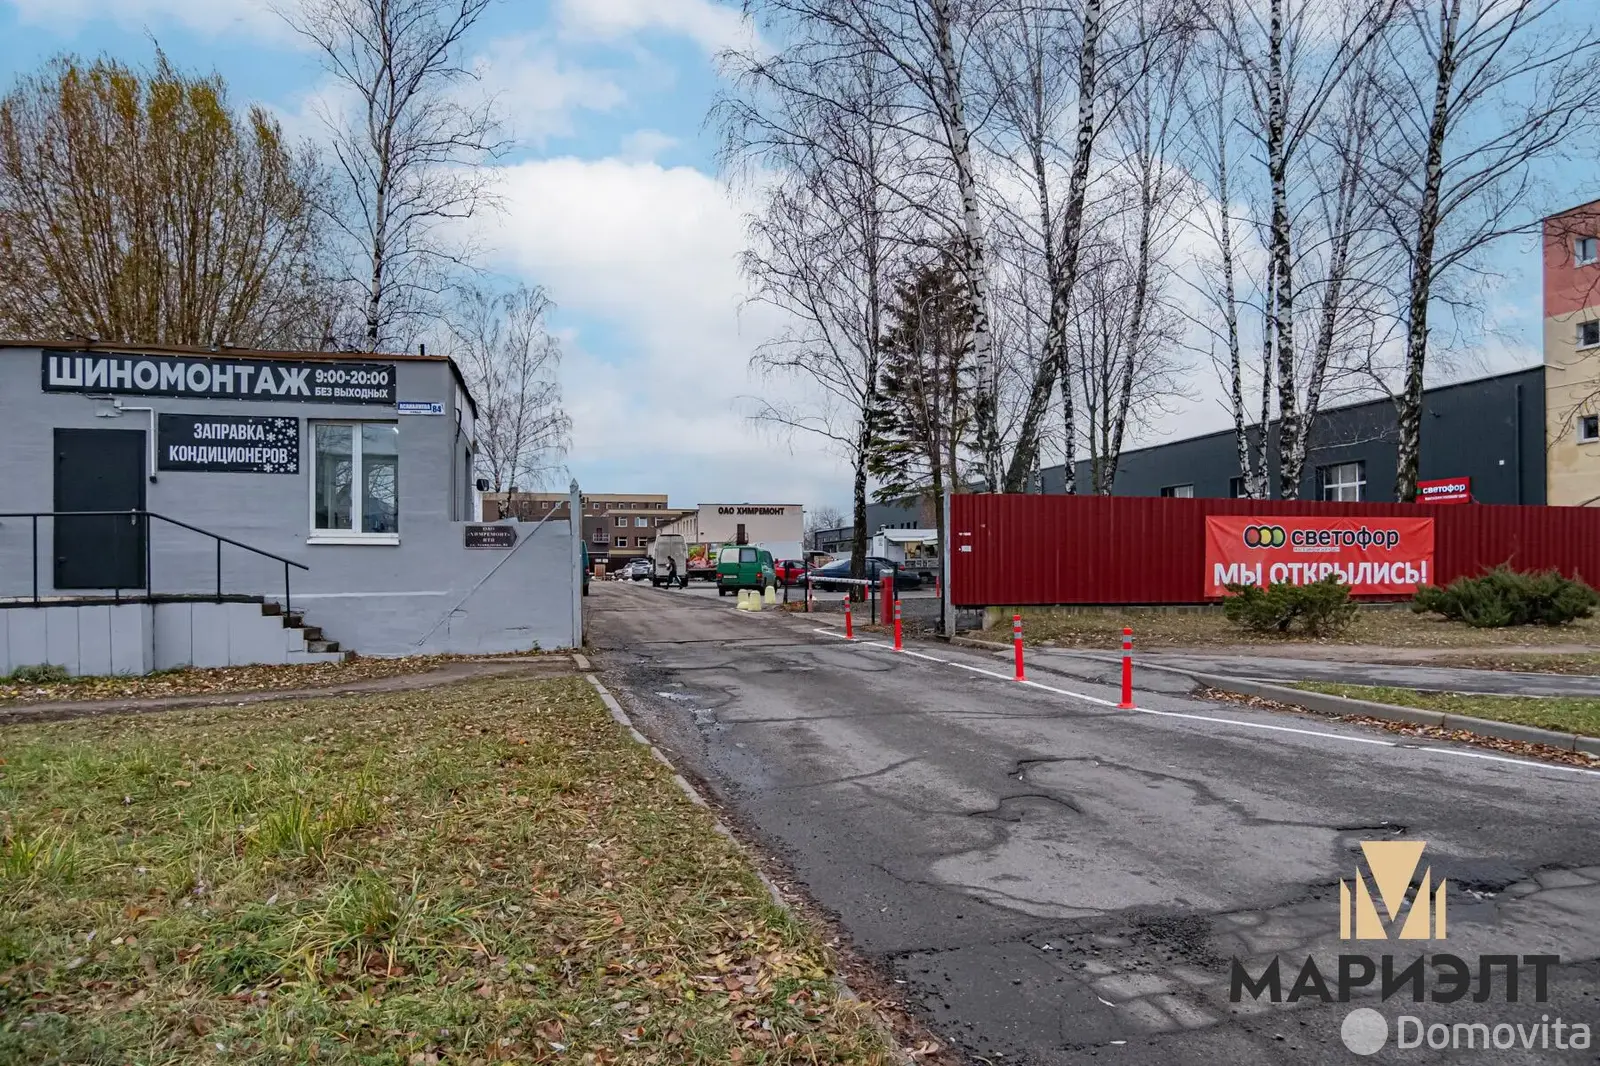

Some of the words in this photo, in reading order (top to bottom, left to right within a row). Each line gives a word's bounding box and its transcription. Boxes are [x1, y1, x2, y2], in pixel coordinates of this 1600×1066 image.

[49, 356, 311, 396] ШИНОМОНТАЖ
[315, 369, 388, 386] 9:00-20:00
[315, 387, 333, 397] БЕЗ
[334, 387, 388, 399] ВЫХОДНЫХ
[432, 405, 442, 413] 84
[193, 422, 265, 441] ЗАПРАВКА
[169, 445, 288, 465] КОНДИЦИОНЕРОВ
[1423, 483, 1466, 494] светофор
[718, 507, 735, 515] ОАО
[737, 507, 785, 516] ХИМРЕМОНТ
[1291, 526, 1399, 549] светофор
[1213, 562, 1263, 586] МЫ
[1269, 560, 1428, 585] ОТКРЫЛИСЬ!
